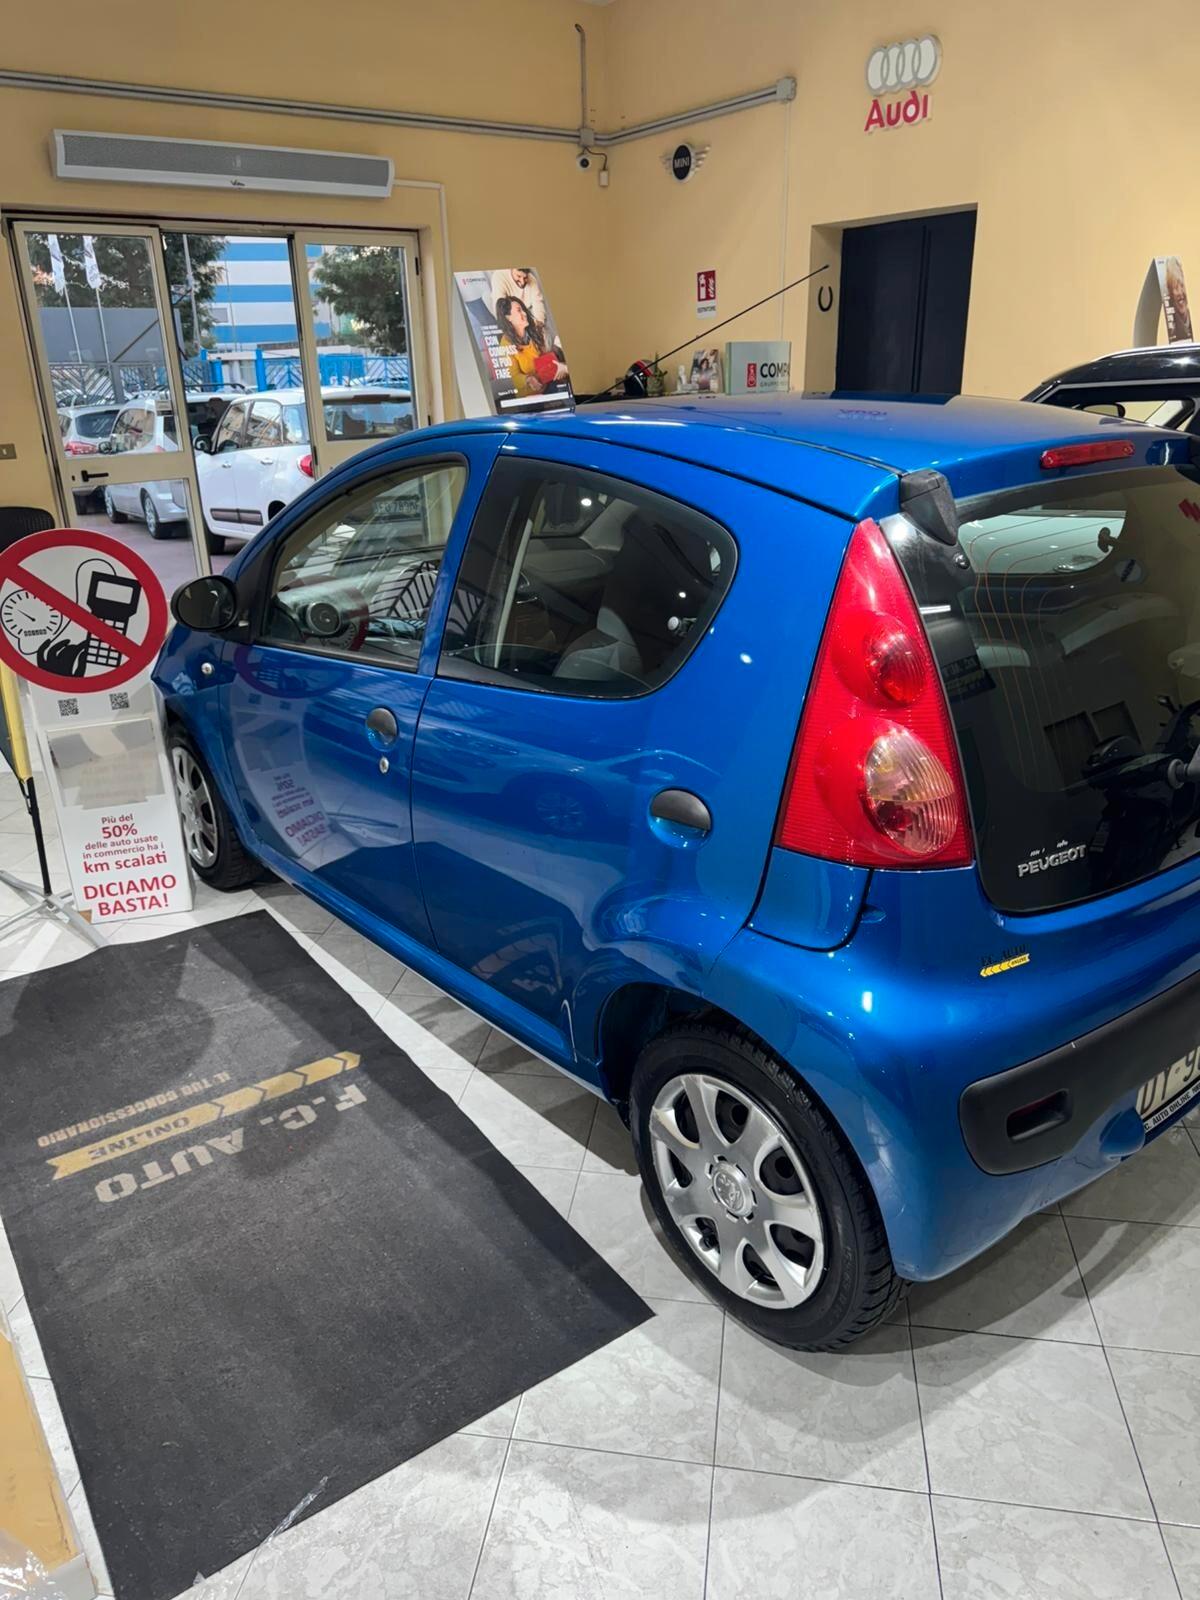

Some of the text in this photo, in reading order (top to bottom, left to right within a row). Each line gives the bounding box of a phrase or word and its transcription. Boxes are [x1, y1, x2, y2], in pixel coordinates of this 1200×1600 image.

[864, 90, 930, 132] Audi
[674, 156, 690, 169] MINI
[101, 813, 133, 824] Più del
[85, 834, 158, 850] delle auto usate
[102, 823, 138, 839] 50%
[82, 851, 92, 860] in
[94, 846, 145, 858] commercio
[147, 843, 159, 851] ha
[84, 851, 167, 873] km scalati
[1017, 844, 1087, 878] PEUGEOT
[83, 874, 176, 900] DICIAMO
[98, 893, 169, 916] BASTA!
[37, 1071, 231, 1148] IL TUO CONCESSIONARIO
[1152, 1108, 1169, 1126] AUTO
[1169, 1091, 1191, 1113] ONLINE
[88, 1116, 191, 1161] ONLINE
[94, 1083, 367, 1203] F.C. AUTO
